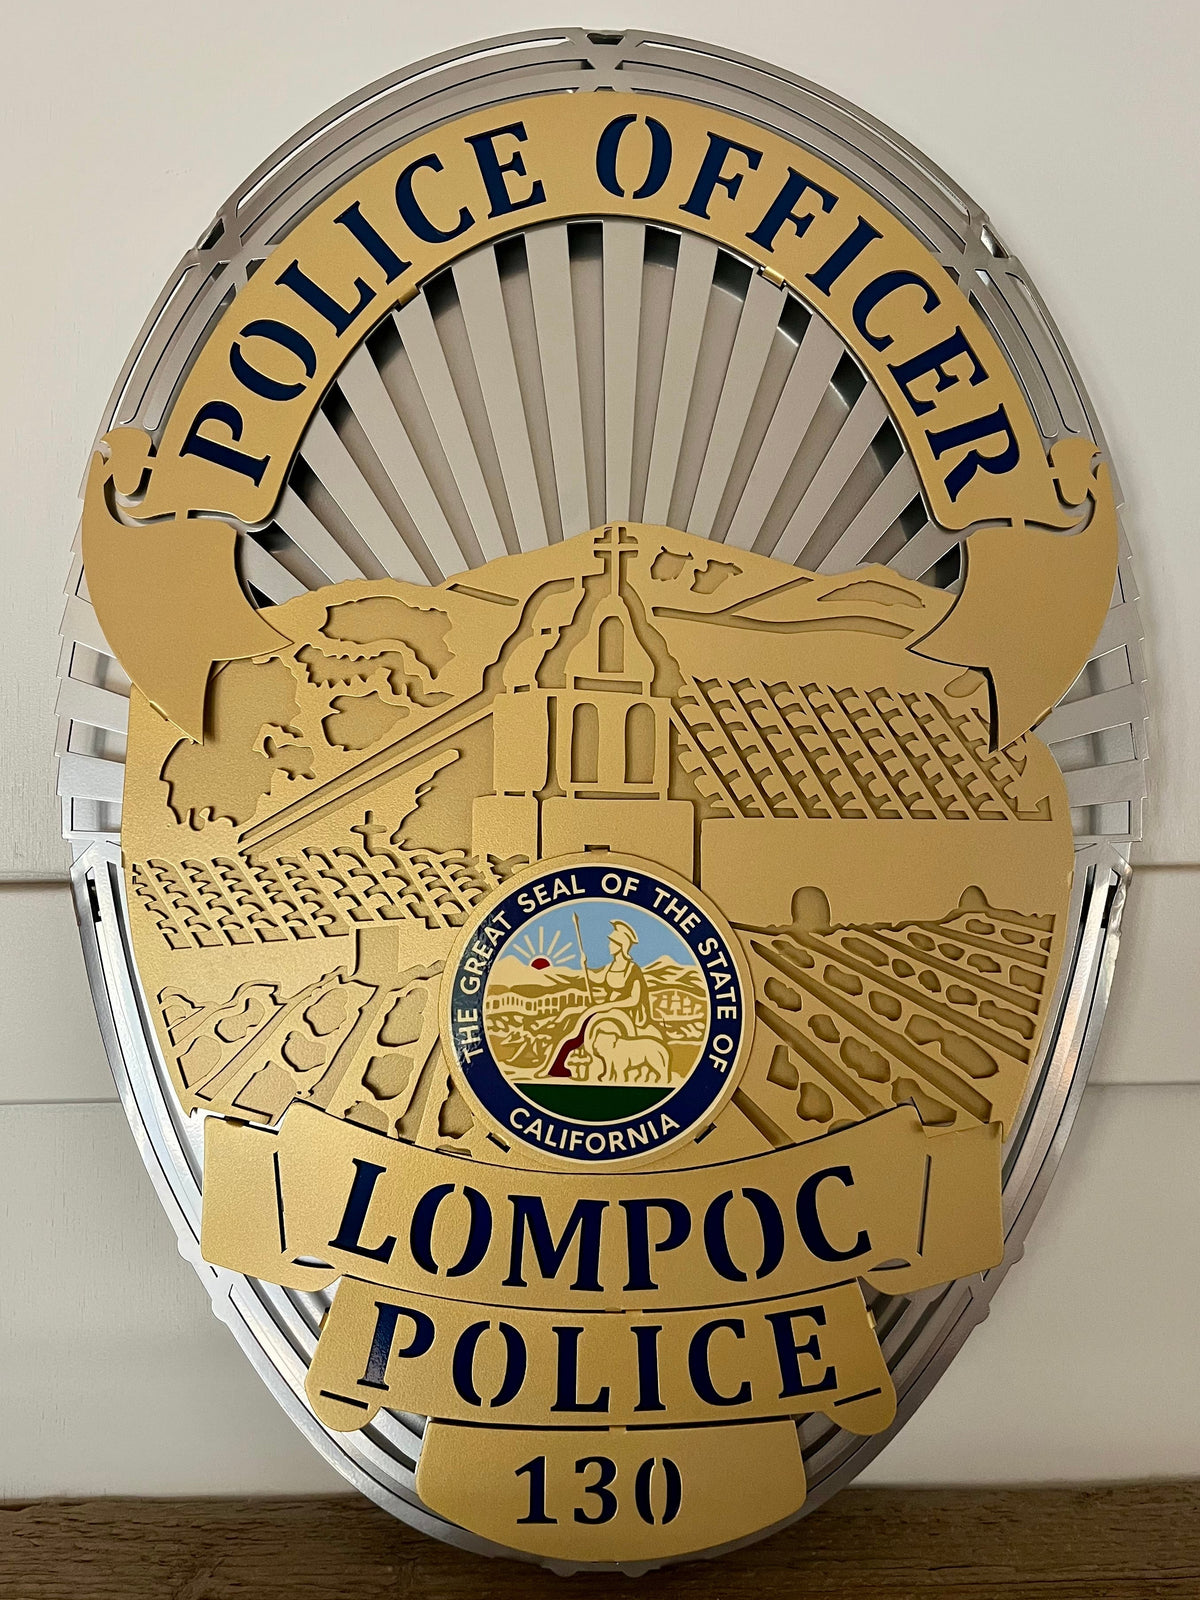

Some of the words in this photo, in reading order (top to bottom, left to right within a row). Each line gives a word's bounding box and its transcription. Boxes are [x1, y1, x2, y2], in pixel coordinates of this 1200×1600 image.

[178, 121, 547, 488] POLICE
[595, 113, 1021, 503] OFFICER
[517, 874, 586, 914] SEAL
[600, 872, 640, 897] OF
[651, 886, 702, 935] THE
[459, 910, 513, 995] GREAT
[697, 937, 737, 1021] STATE
[457, 1007, 484, 1064] THE
[708, 1033, 734, 1074] OF
[509, 1107, 681, 1154] CALIFORNIA
[328, 1157, 872, 1292] LOMPOC
[356, 1301, 840, 1413] POLICE
[513, 1454, 683, 1526] 130
